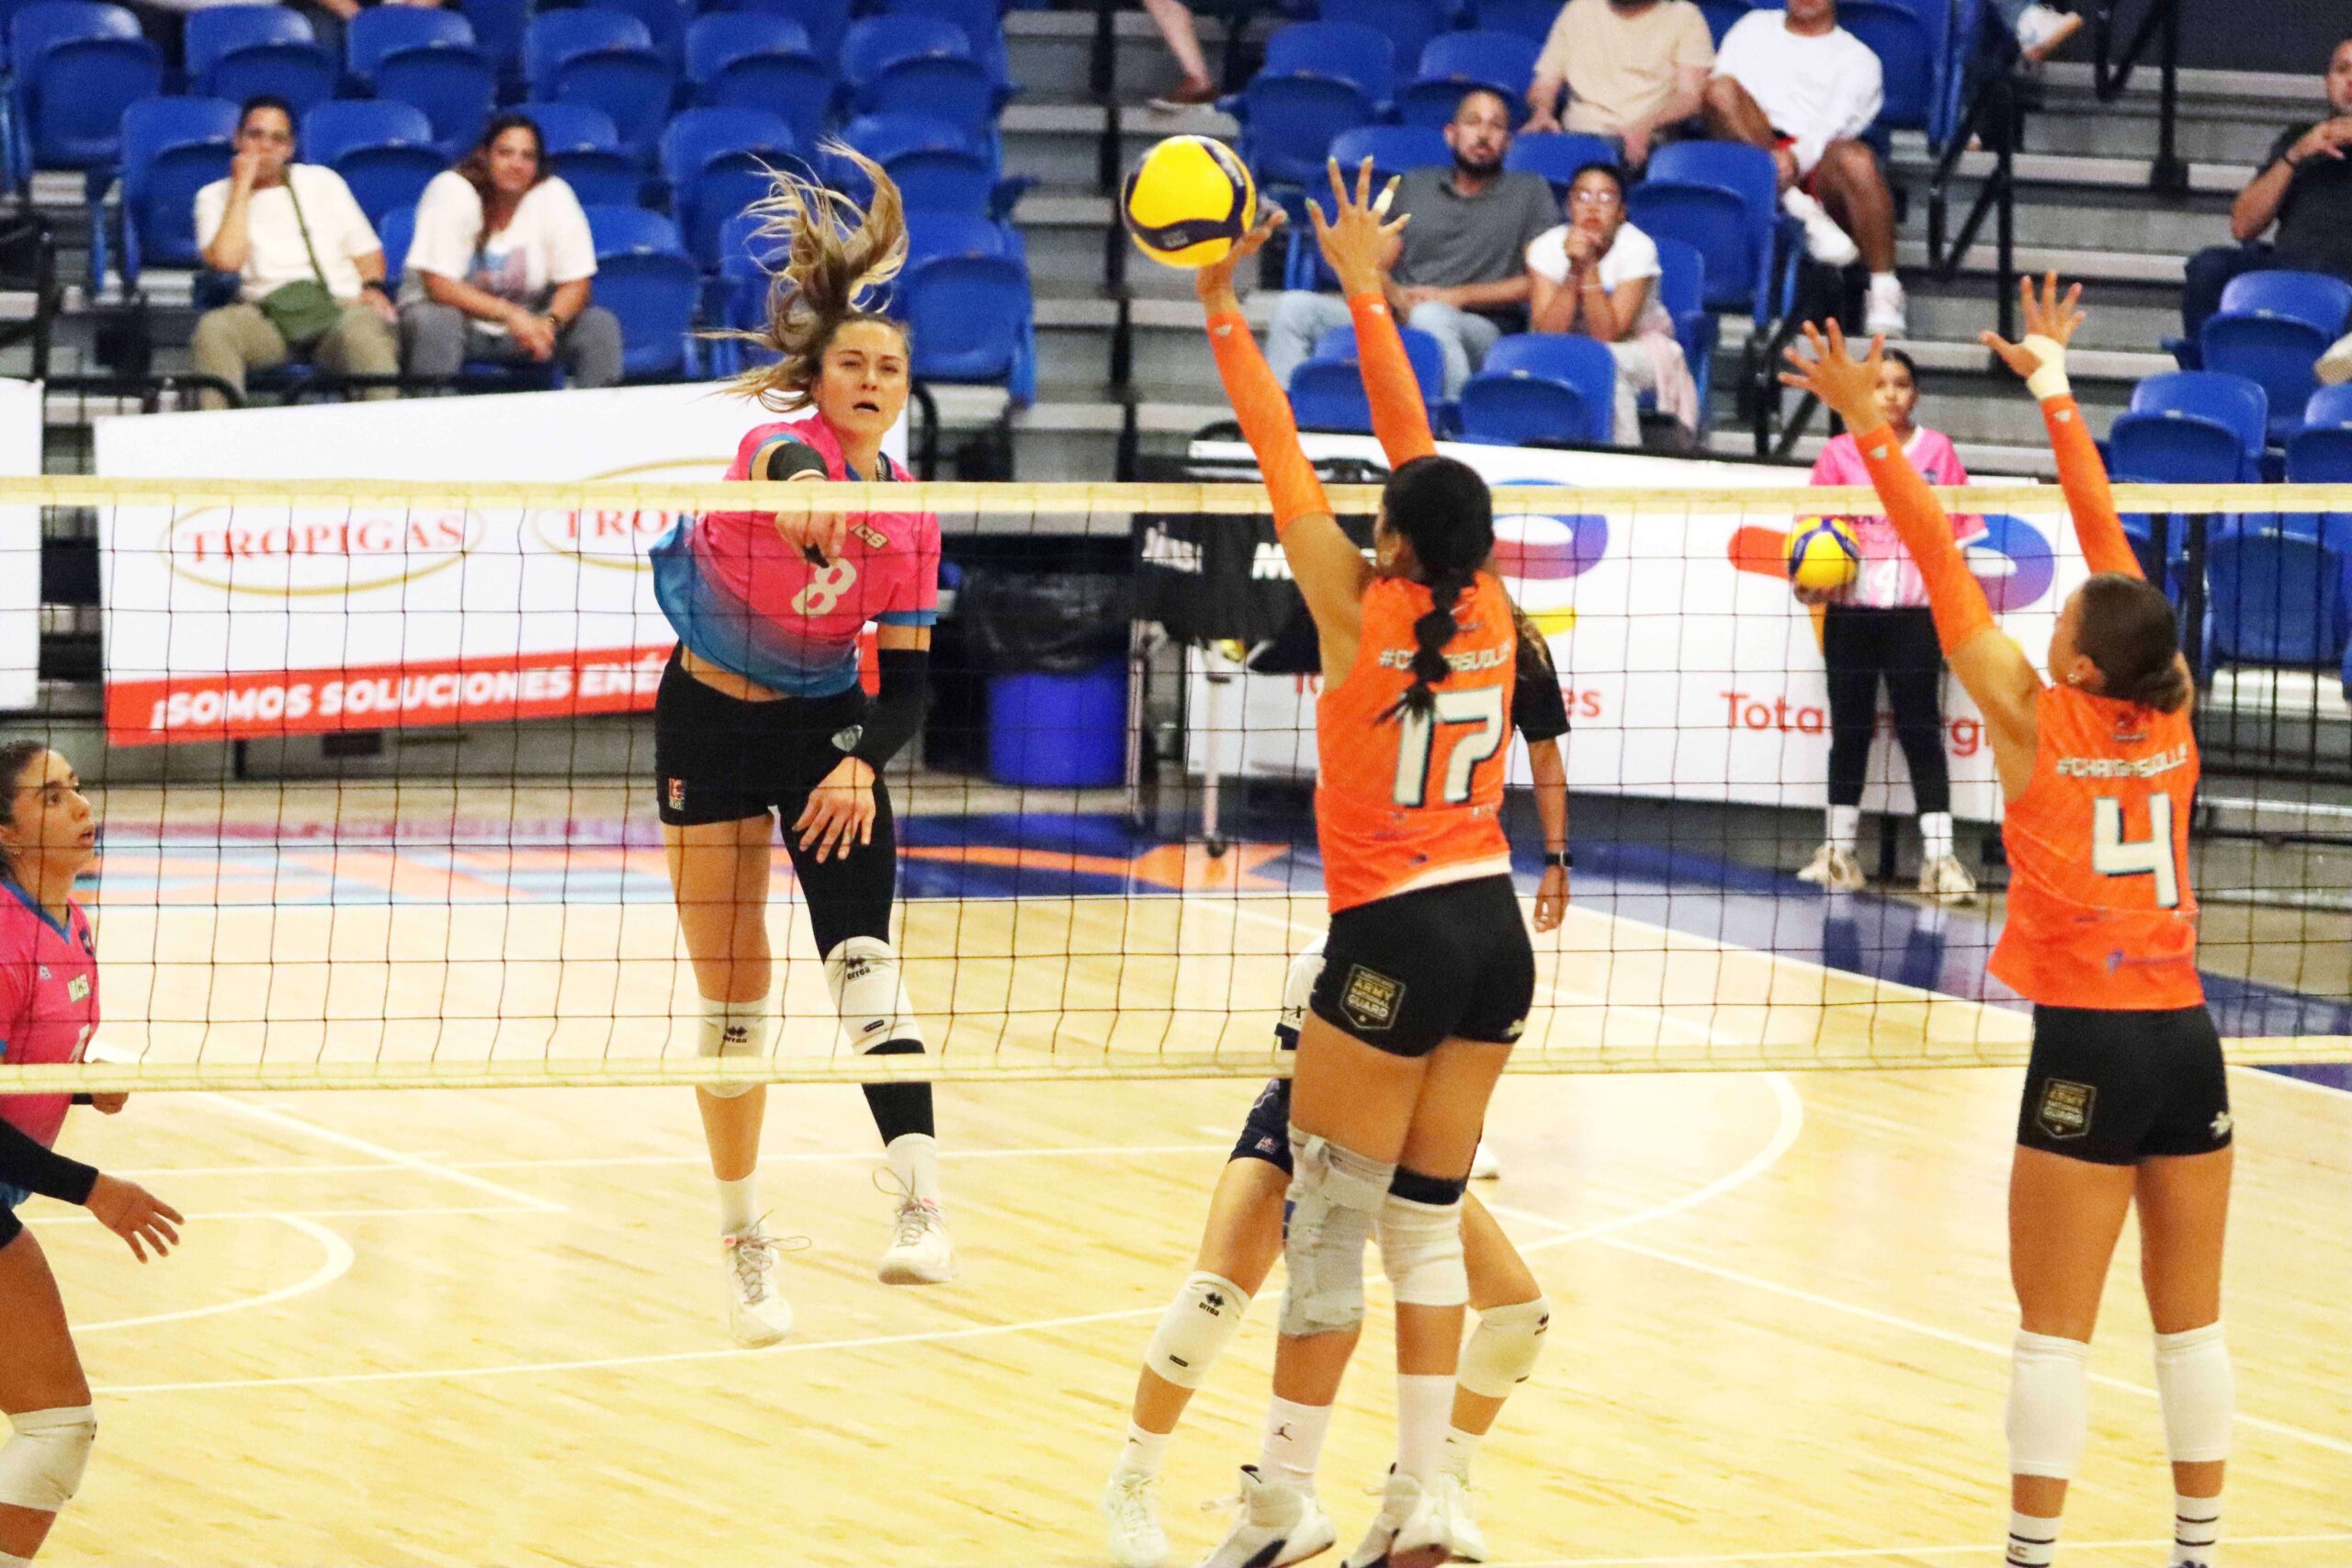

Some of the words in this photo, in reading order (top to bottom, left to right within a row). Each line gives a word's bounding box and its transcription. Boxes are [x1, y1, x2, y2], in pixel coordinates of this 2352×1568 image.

[186, 513, 465, 563] TROPIGAS
[791, 557, 857, 616] 8
[150, 684, 313, 734] ¡SOMOS
[318, 667, 572, 716] SOLUCIONES
[578, 651, 669, 699] ENÉ
[1392, 685, 1502, 807] 17
[2093, 792, 2179, 908] 4
